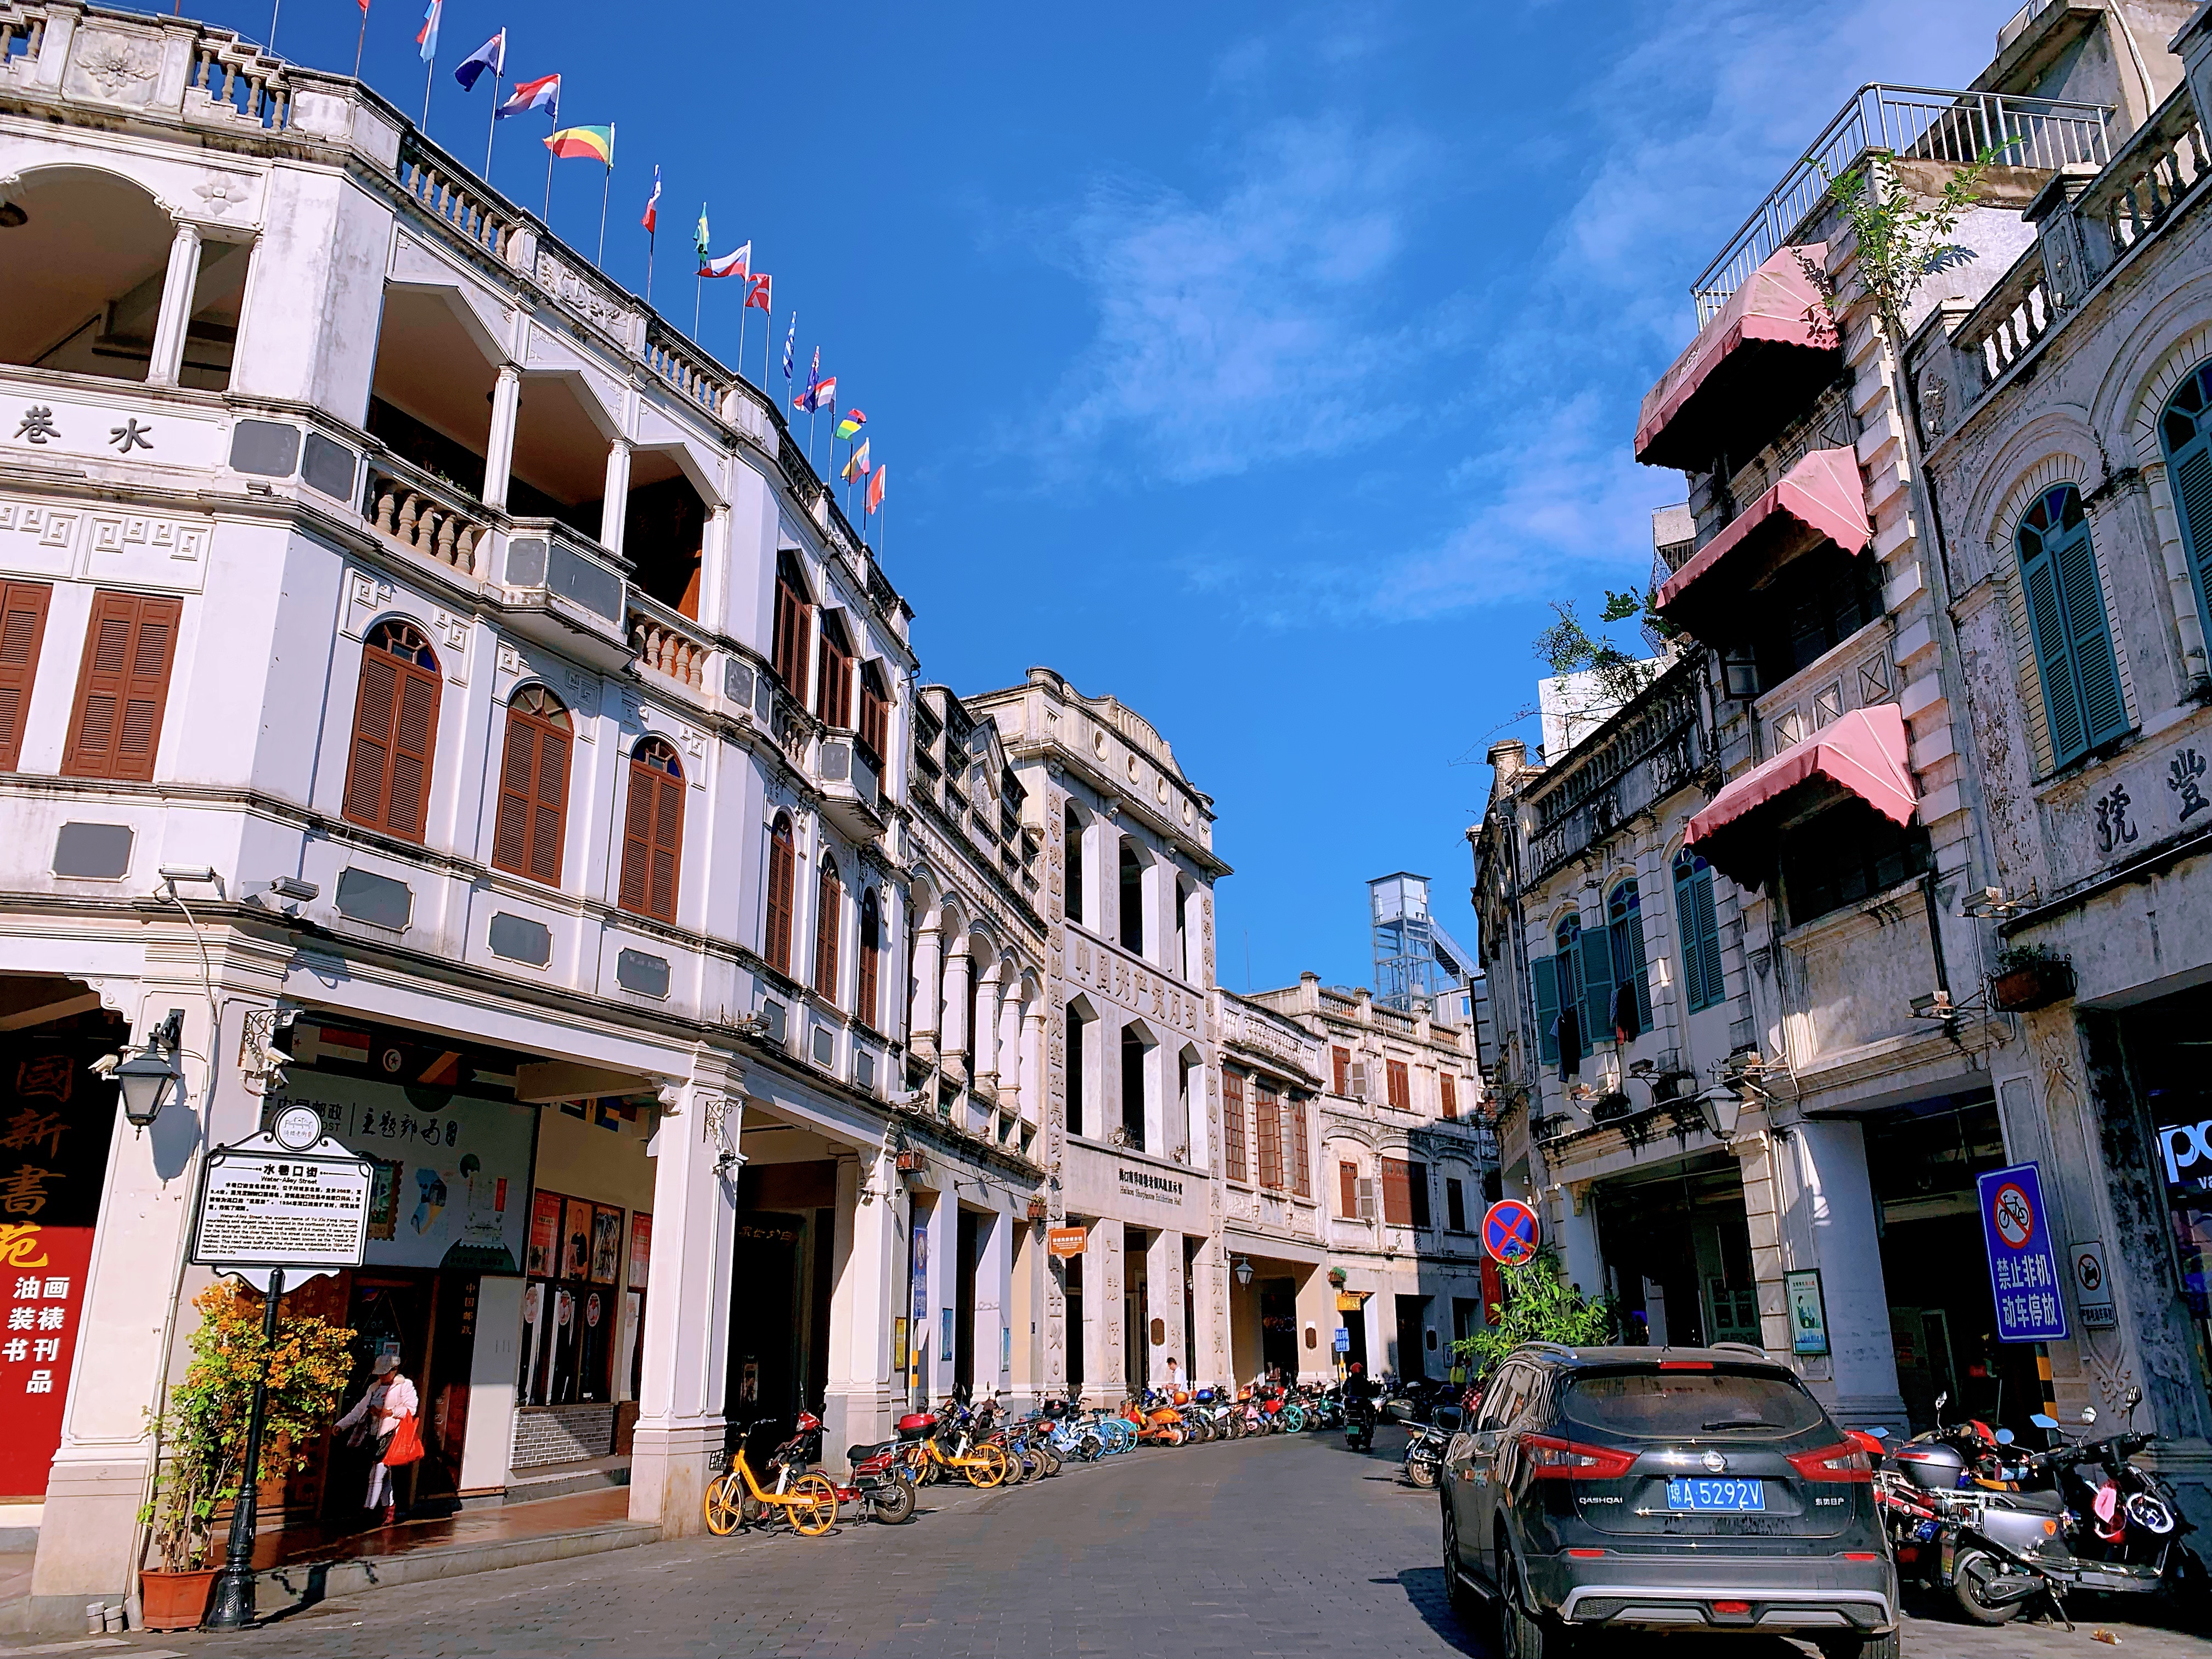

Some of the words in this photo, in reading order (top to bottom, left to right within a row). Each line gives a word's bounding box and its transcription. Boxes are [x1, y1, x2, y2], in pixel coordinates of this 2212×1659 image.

[261, 1176, 297, 1184] Water-Alley
[263, 1164, 318, 1177] 水巷口街
[1996, 1254, 2051, 1290] 禁止非机
[13, 1276, 71, 1300] 油画
[7, 1306, 66, 1331] 装裱
[461, 1282, 476, 1336] 中国邮政
[2002, 1292, 2058, 1328] 动车停放
[1, 1338, 60, 1363] 书刊
[1579, 1497, 1623, 1505] QASHQAI
